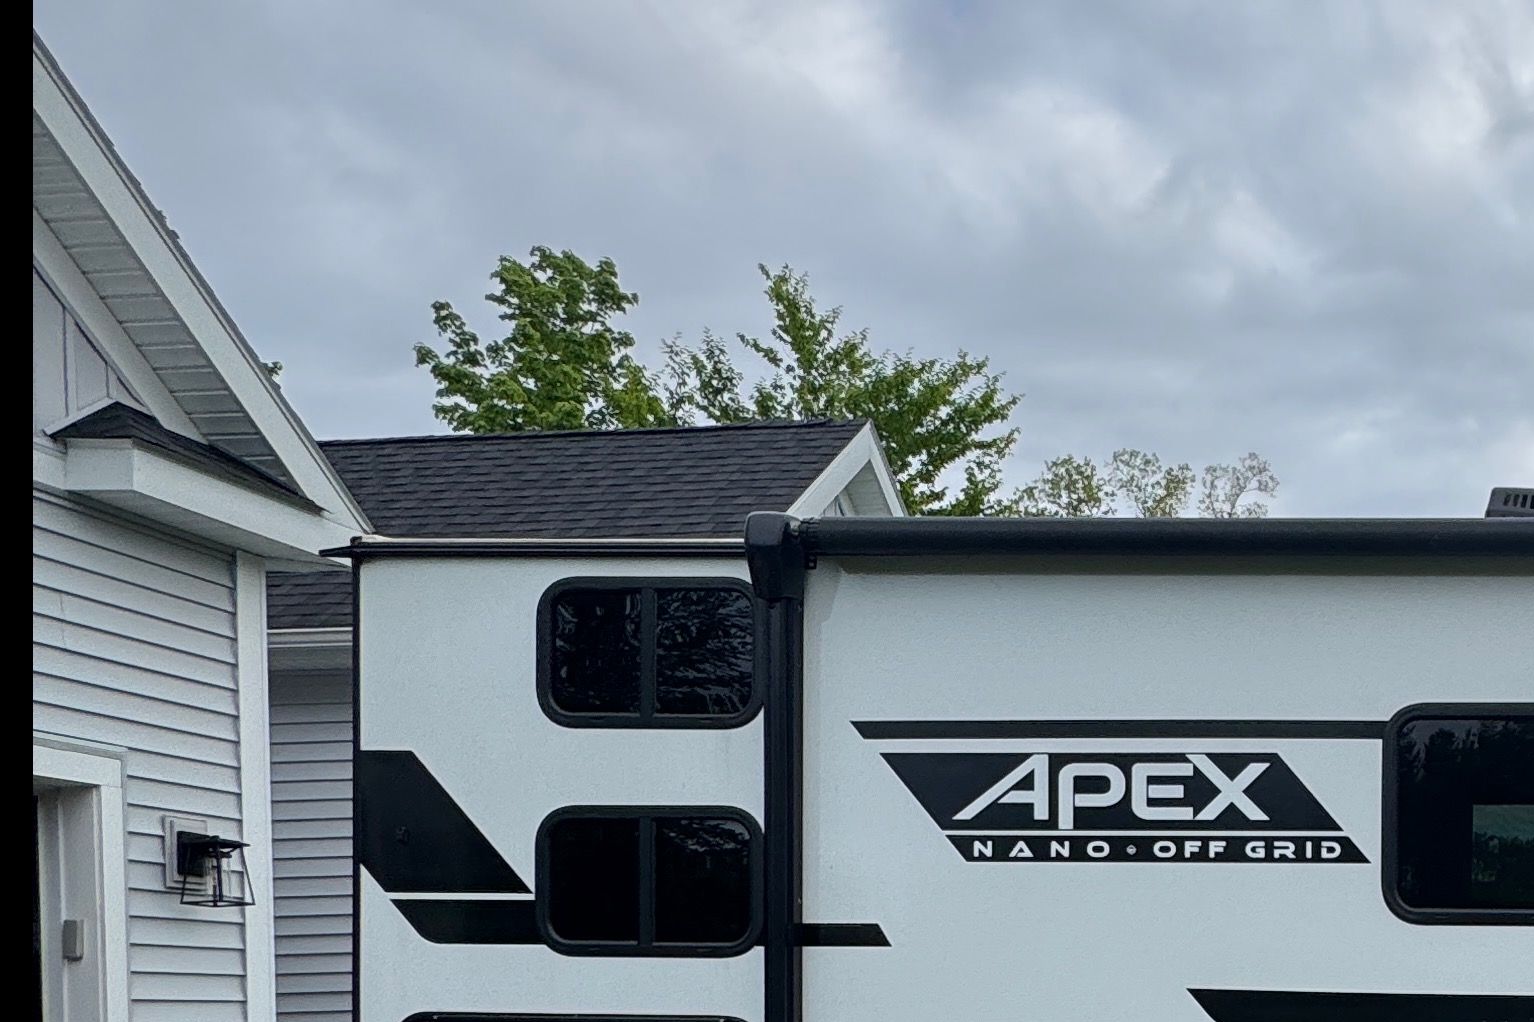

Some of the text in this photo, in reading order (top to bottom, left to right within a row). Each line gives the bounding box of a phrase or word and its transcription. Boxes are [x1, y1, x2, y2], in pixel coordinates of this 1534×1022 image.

[951, 753, 1272, 830] APEX
[972, 840, 1342, 859] NANO OFF GRID
